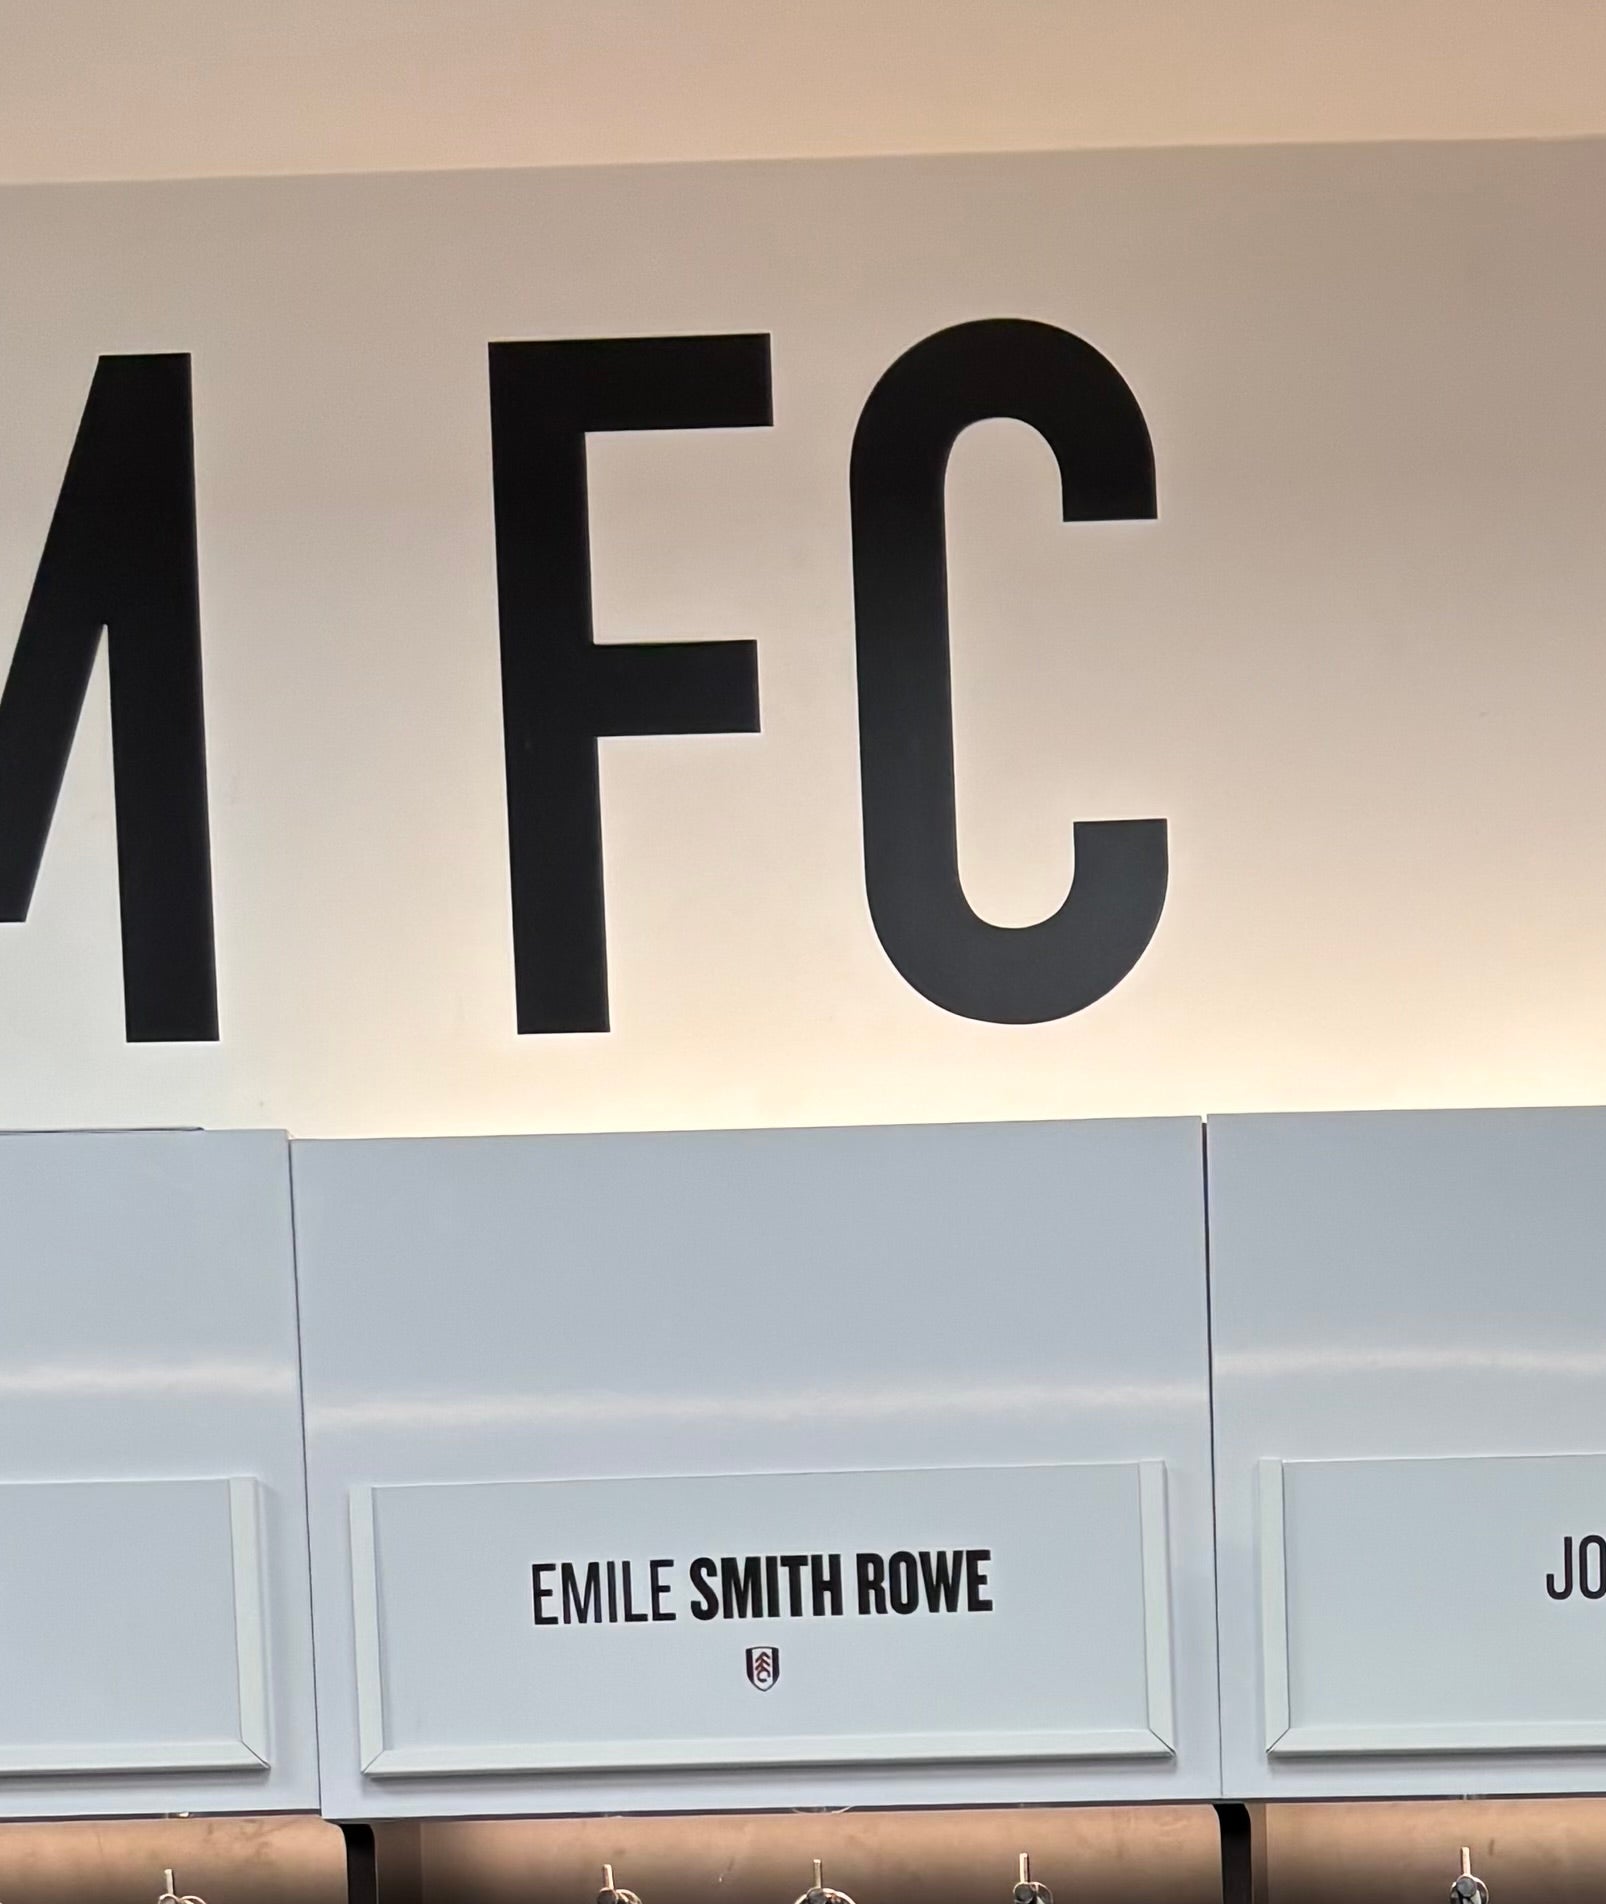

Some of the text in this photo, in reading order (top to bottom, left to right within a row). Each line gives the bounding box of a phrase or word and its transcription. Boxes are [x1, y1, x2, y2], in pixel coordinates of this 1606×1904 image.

[488, 317, 1169, 1035] FC
[532, 1549, 994, 1625] EMILE SMITH ROWE
